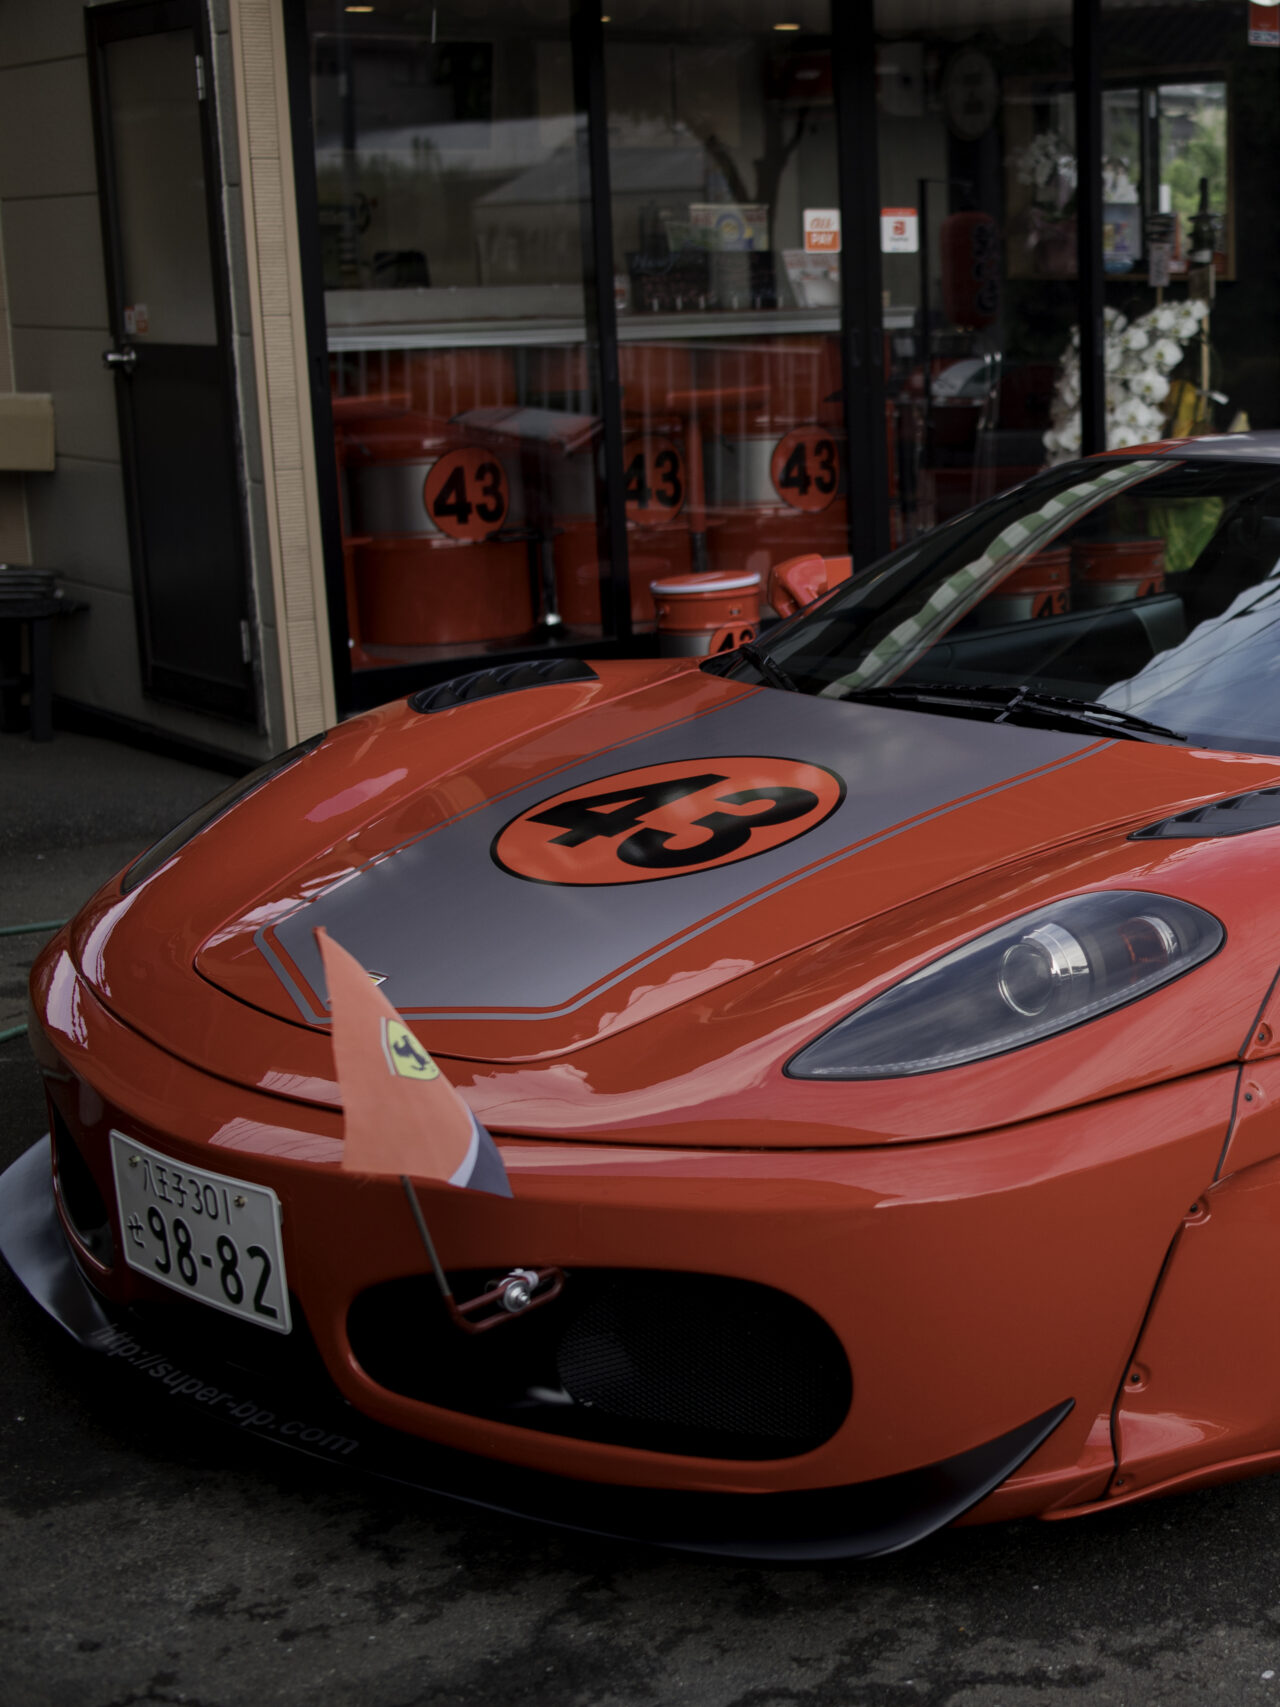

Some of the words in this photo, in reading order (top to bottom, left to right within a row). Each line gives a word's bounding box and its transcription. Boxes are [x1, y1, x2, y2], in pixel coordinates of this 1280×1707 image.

[810, 233, 834, 245] PAY
[433, 461, 505, 525] 43
[624, 450, 682, 510] 43
[780, 439, 837, 496] 43
[525, 773, 820, 869] 43
[127, 1211, 146, 1249] せ
[148, 1205, 278, 1320] 98-82
[89, 1322, 361, 1456] http://super-bp.com
